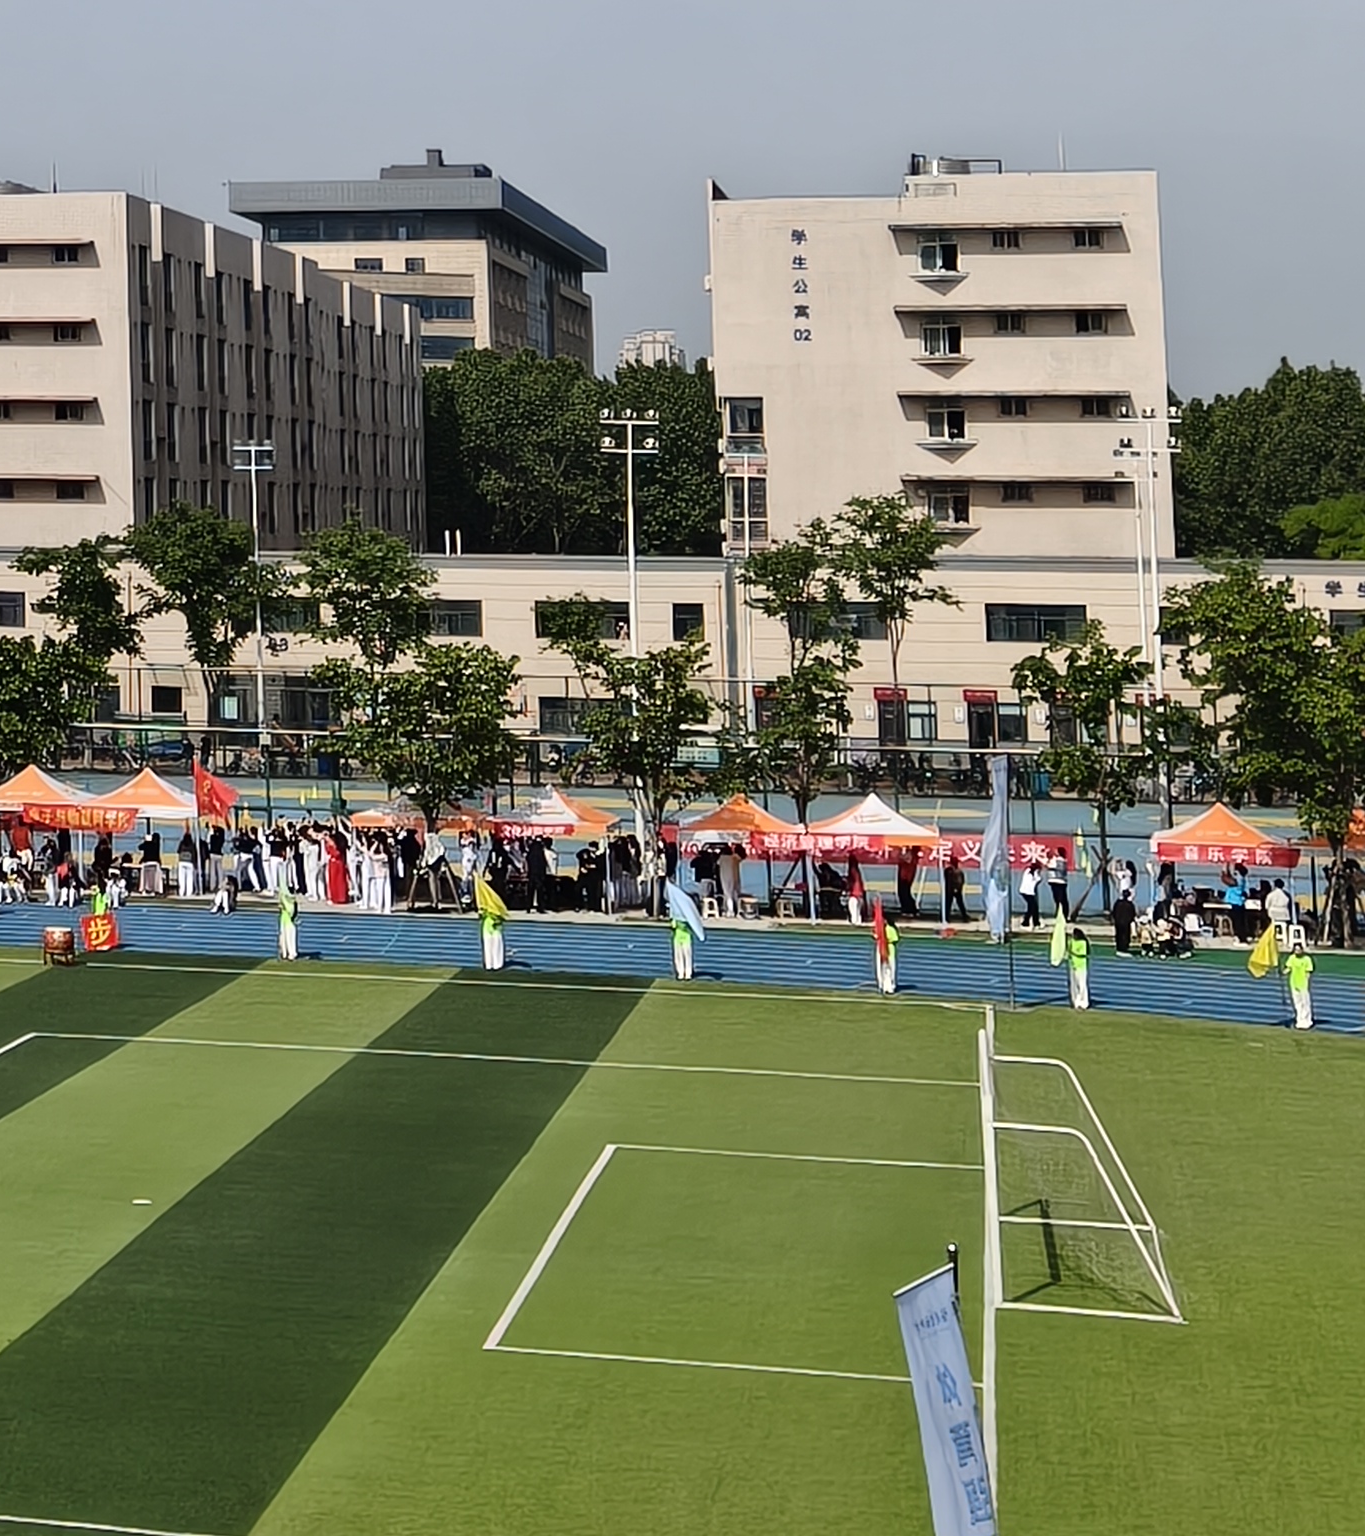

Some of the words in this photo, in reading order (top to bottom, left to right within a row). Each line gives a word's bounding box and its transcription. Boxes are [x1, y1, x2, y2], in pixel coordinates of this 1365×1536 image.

[1183, 845, 1273, 865] 音乐学院
[88, 917, 112, 946] 步
